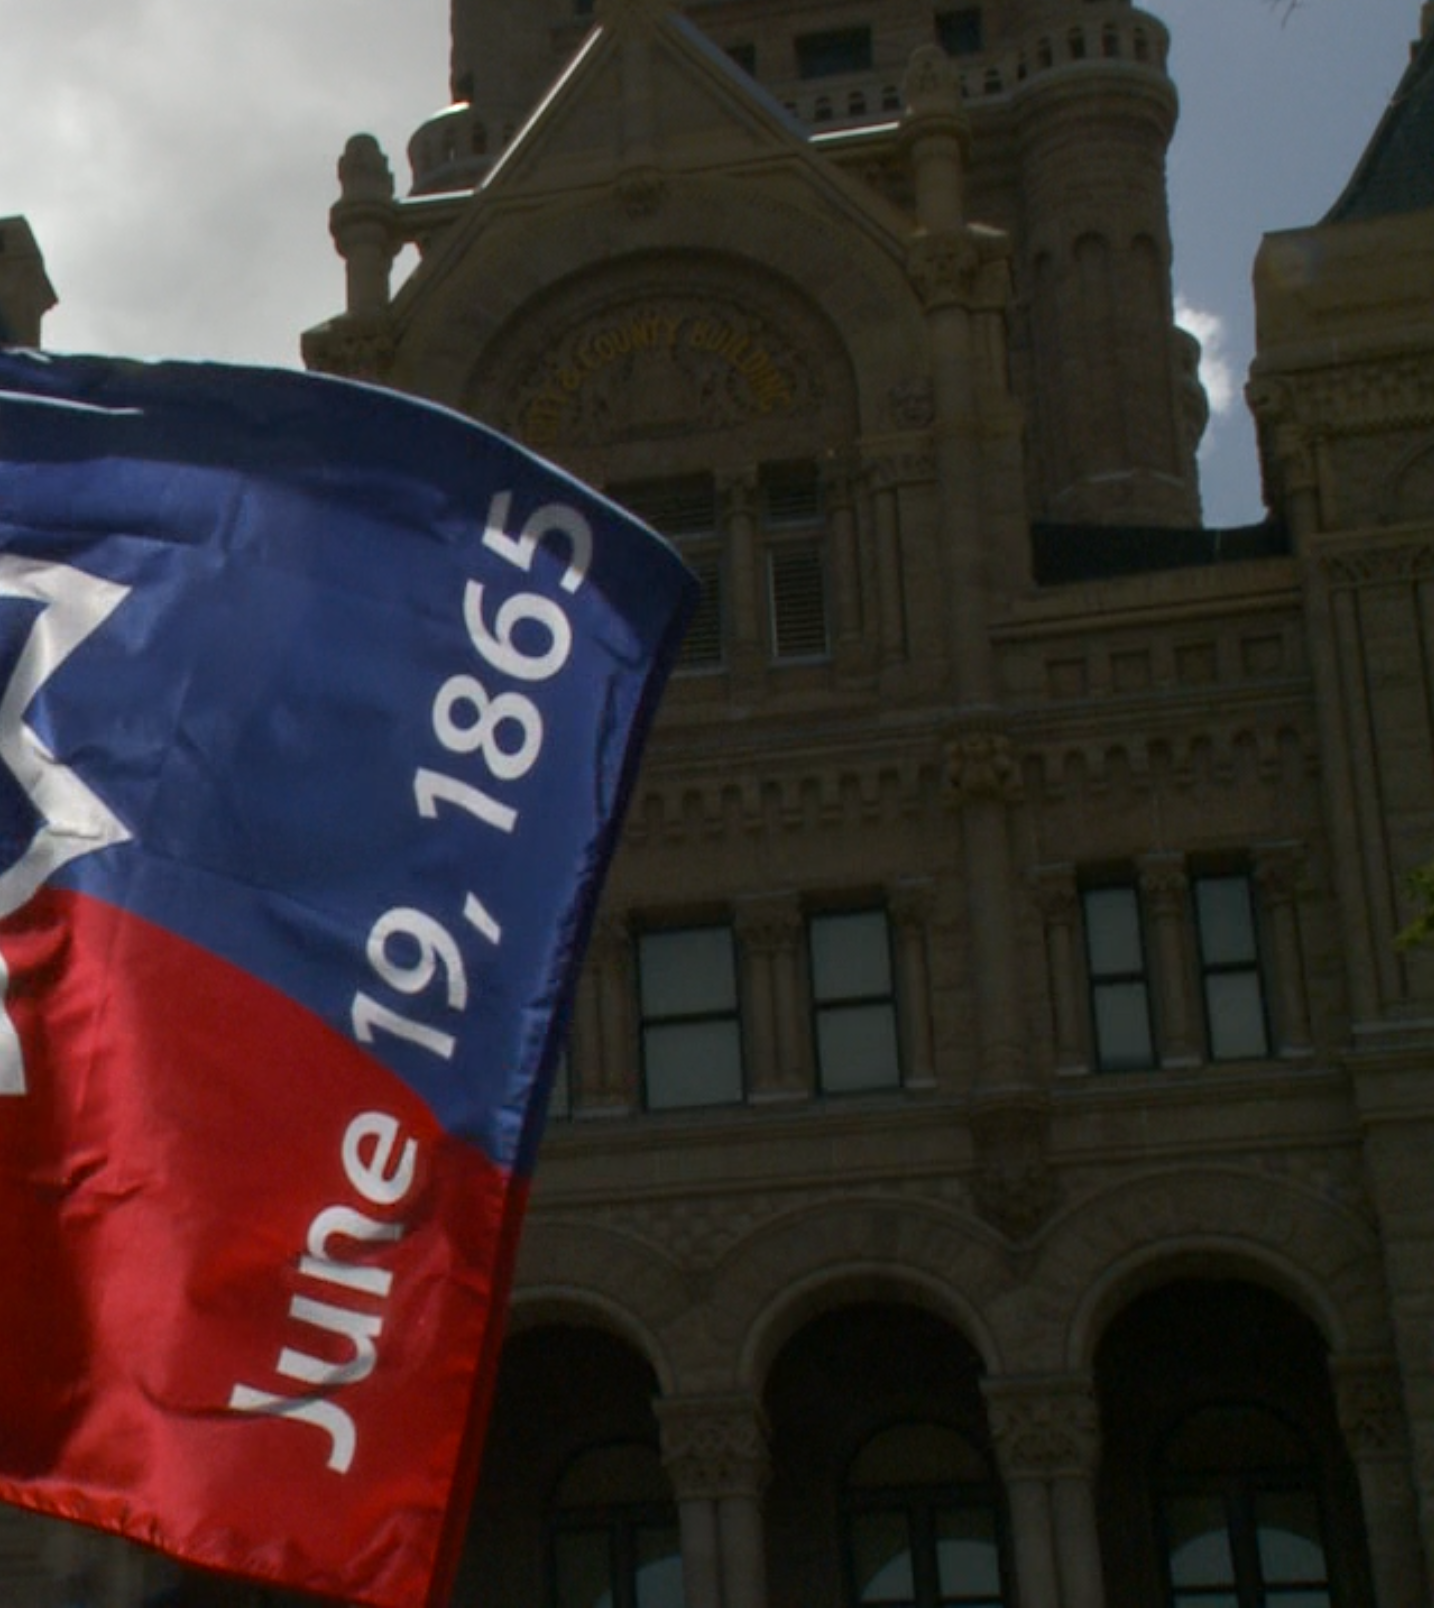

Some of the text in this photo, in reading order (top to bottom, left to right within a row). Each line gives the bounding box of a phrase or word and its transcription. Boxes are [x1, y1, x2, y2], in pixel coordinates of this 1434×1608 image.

[559, 368, 580, 391] &
[578, 314, 683, 370] COUNTY
[689, 317, 792, 413] BUILDING
[228, 489, 594, 1474] June 19, 1865
